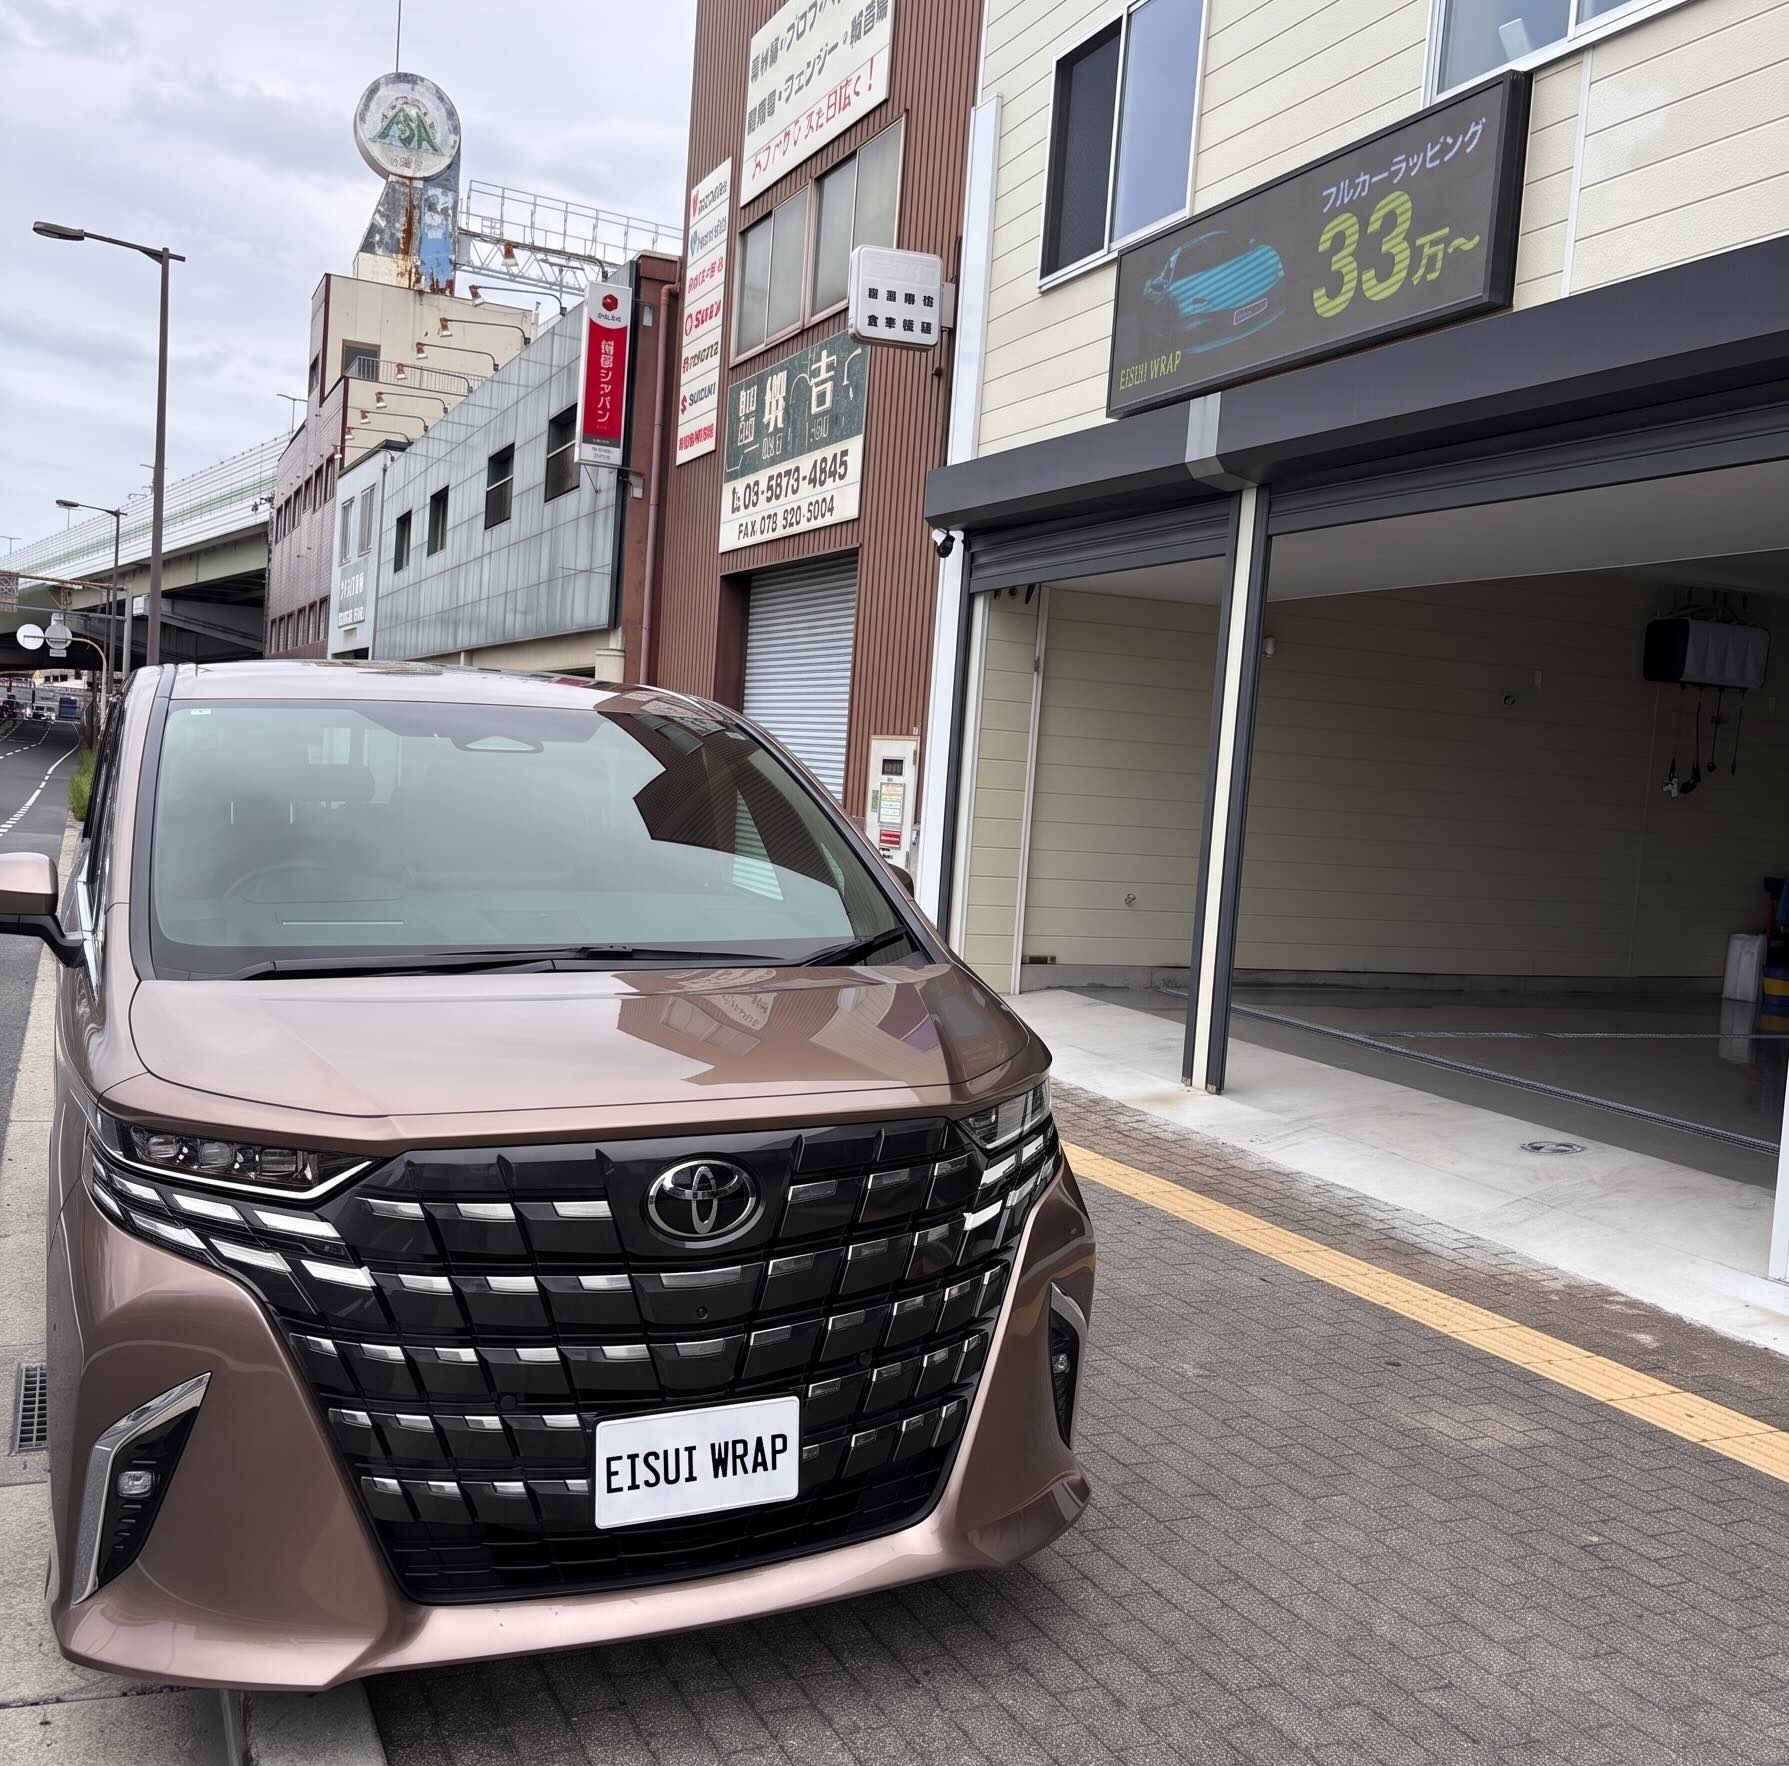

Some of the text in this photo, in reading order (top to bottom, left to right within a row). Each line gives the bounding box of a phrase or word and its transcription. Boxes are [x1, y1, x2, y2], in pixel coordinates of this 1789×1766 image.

[1322, 117, 1487, 214] フルカーラッピング
[1150, 350, 1182, 379] WRAP
[737, 518, 757, 541] FAX
[605, 1433, 788, 1494] EISUI WRAP
